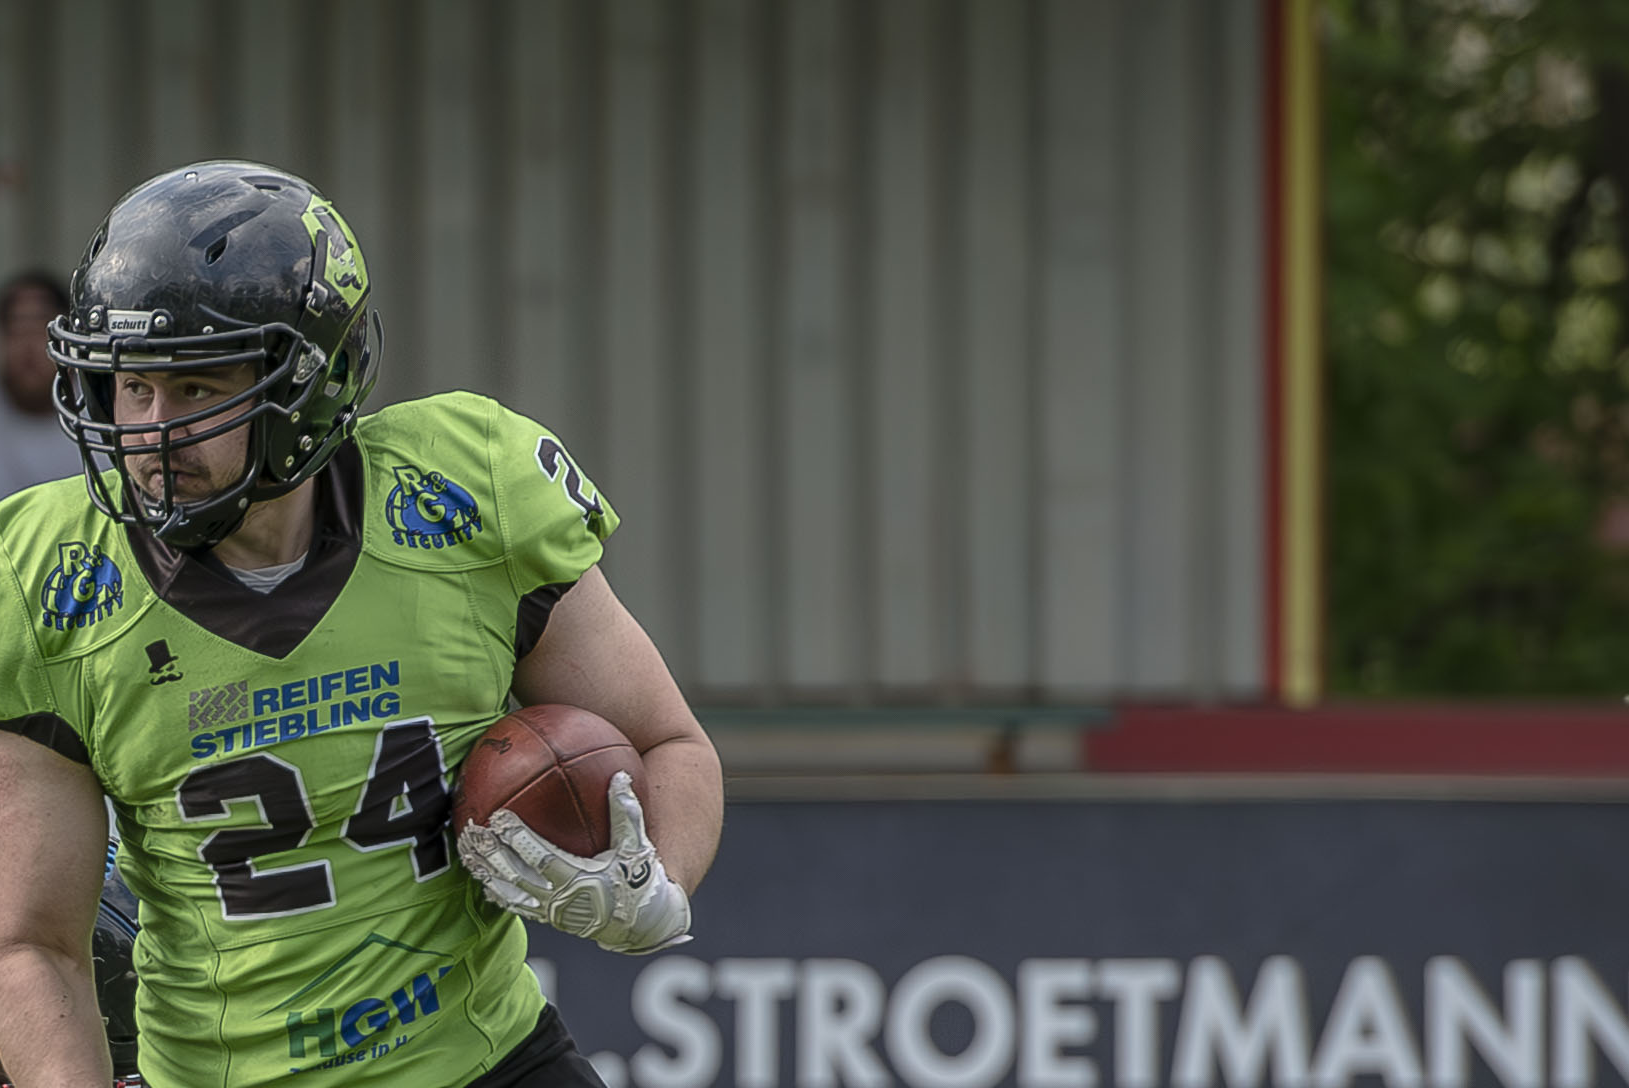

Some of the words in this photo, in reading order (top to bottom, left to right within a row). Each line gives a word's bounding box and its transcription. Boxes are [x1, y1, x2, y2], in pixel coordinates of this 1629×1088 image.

[111, 318, 148, 331] schutt
[252, 660, 400, 716] REIFEN
[190, 692, 401, 759] STIEBLING
[173, 714, 451, 921] 24
[371, 1042, 391, 1059] in
